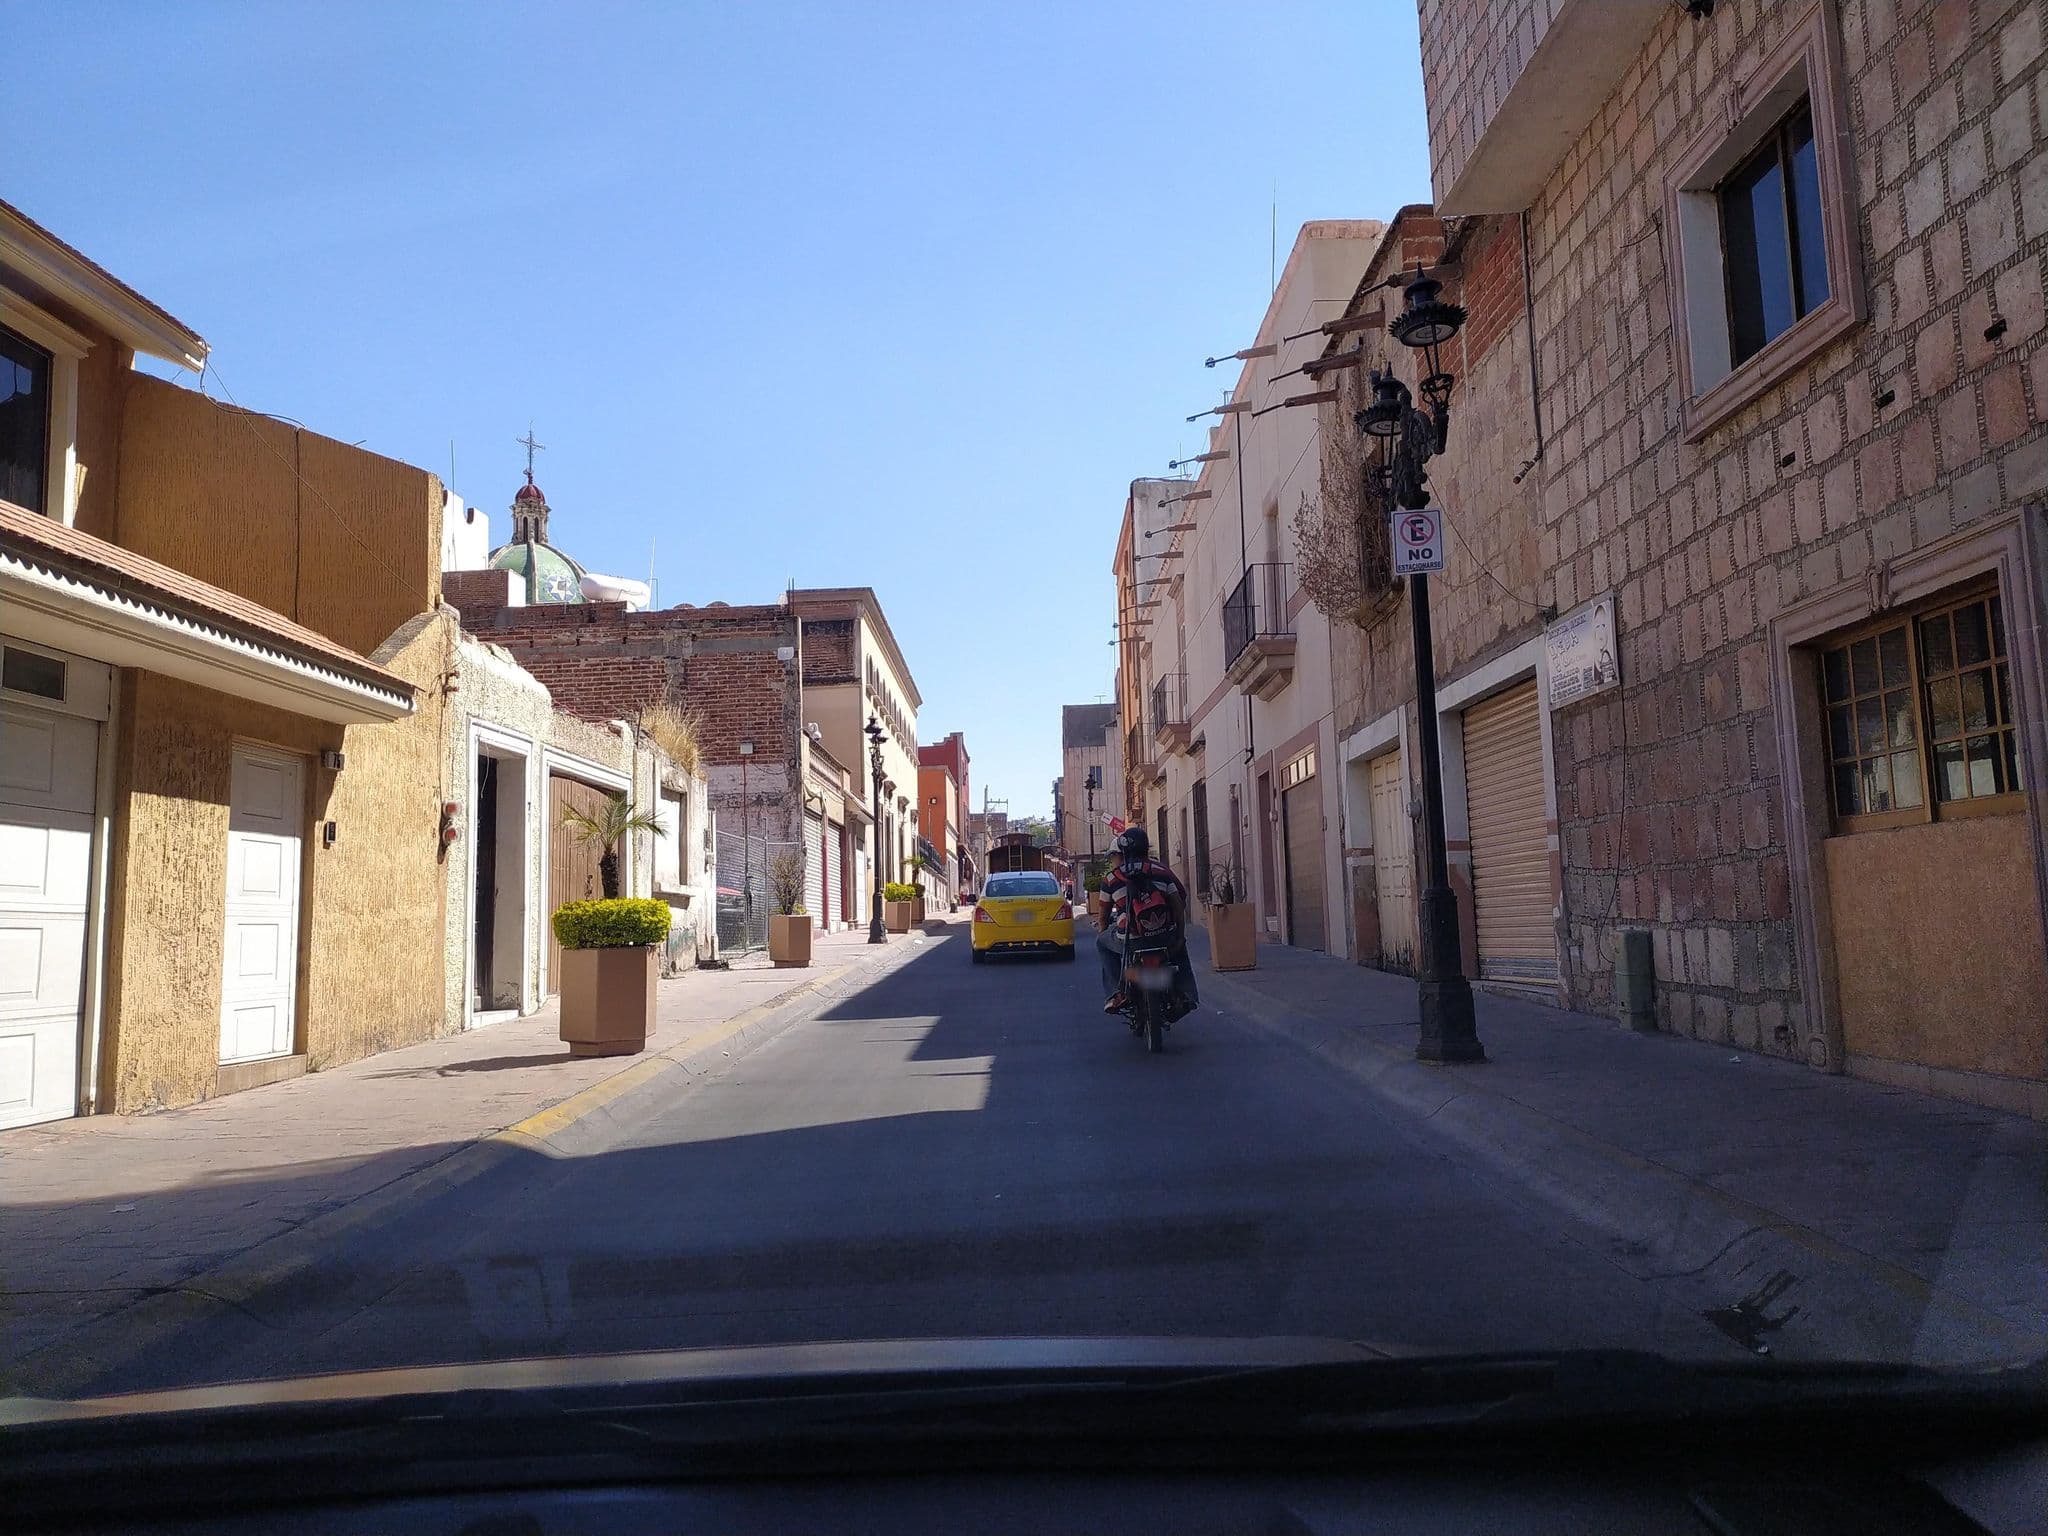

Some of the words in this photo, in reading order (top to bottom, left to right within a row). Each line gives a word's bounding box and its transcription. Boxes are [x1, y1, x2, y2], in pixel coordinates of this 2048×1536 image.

[1410, 519, 1425, 541] E
[1408, 548, 1433, 561] NO
[1398, 561, 1441, 571] ESTACIONARSE
